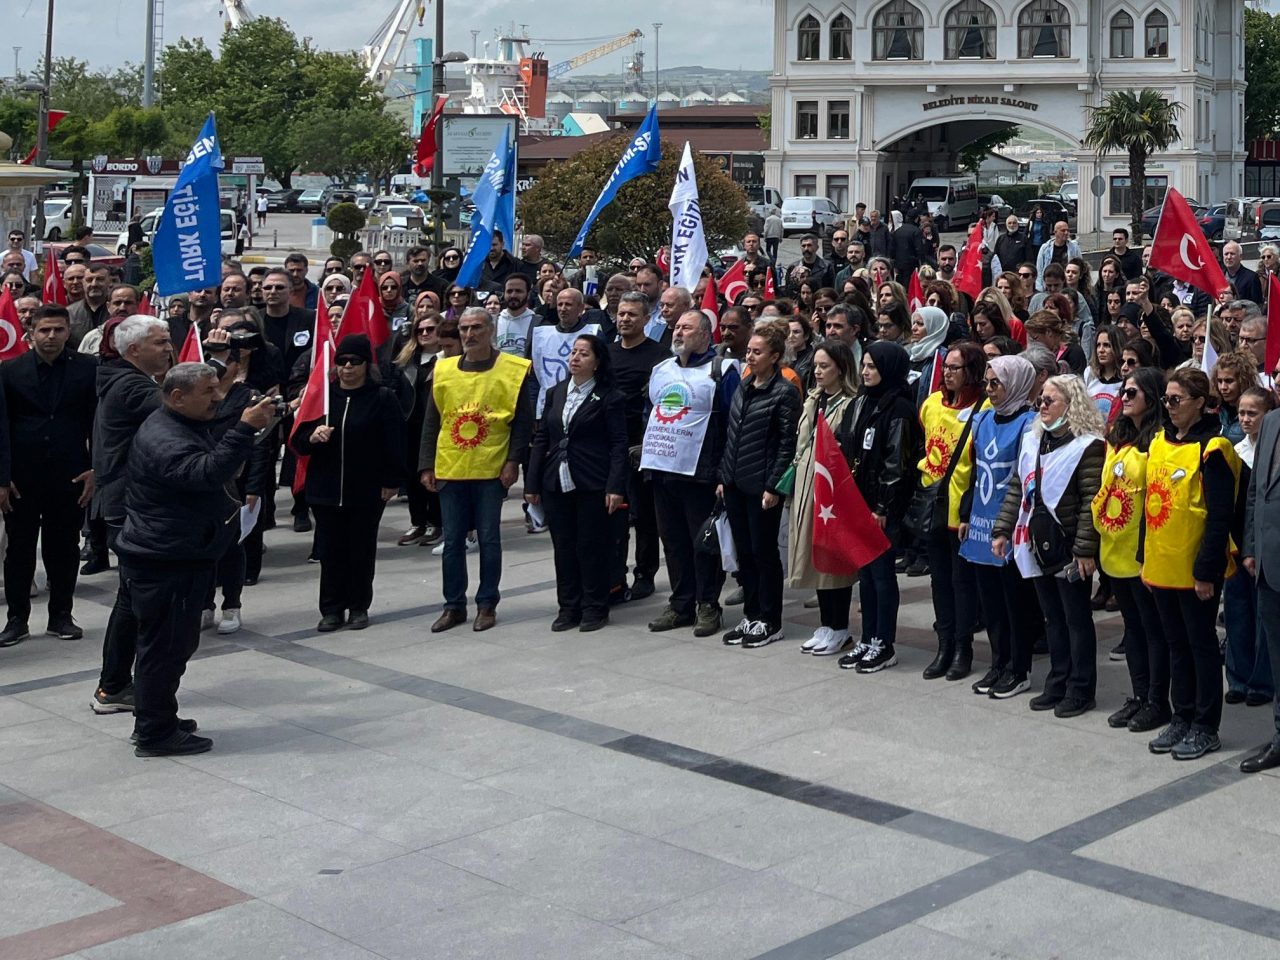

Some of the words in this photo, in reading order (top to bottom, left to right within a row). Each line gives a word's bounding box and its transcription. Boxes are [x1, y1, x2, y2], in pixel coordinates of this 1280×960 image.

[923, 94, 955, 111] BELEDİYE
[967, 94, 999, 104] NİKAH
[1000, 97, 1038, 111] SALONU
[106, 162, 139, 171] BORDO
